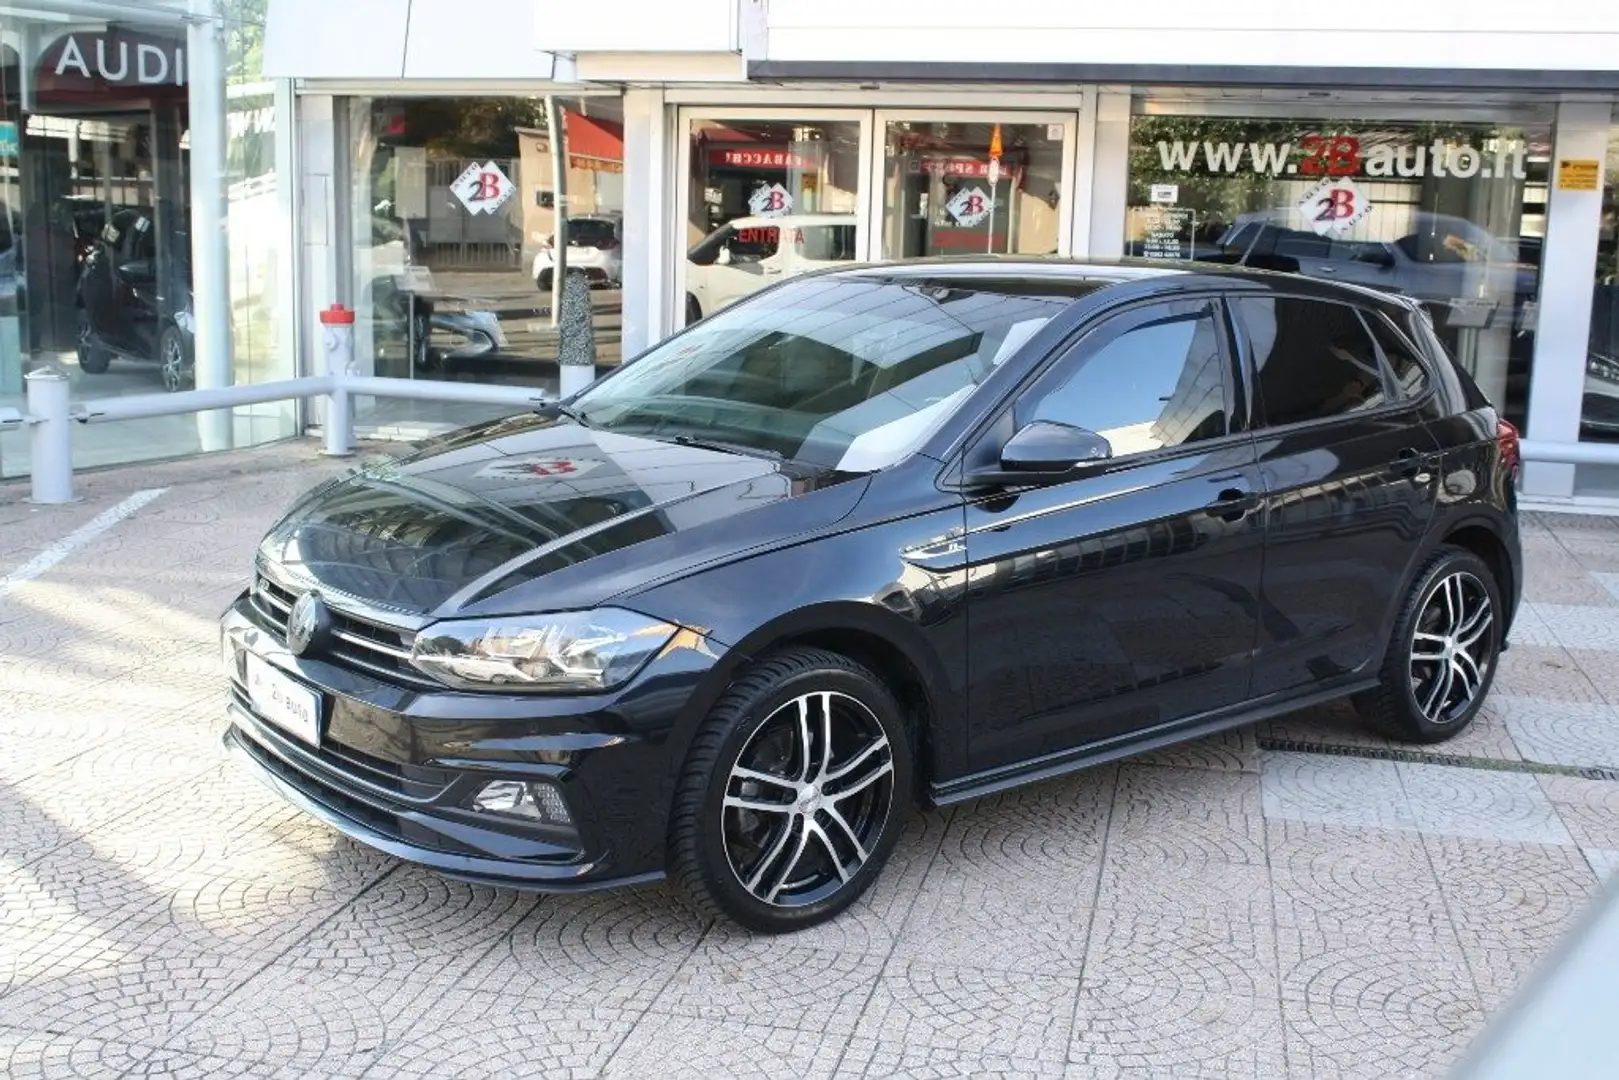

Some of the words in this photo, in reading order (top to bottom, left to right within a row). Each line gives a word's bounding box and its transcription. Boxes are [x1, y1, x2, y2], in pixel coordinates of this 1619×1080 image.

[55, 36, 183, 87] AUDI
[468, 172, 500, 202] 2B
[761, 191, 785, 212] 2B
[959, 194, 984, 217] 2B
[1315, 189, 1354, 221] 2B
